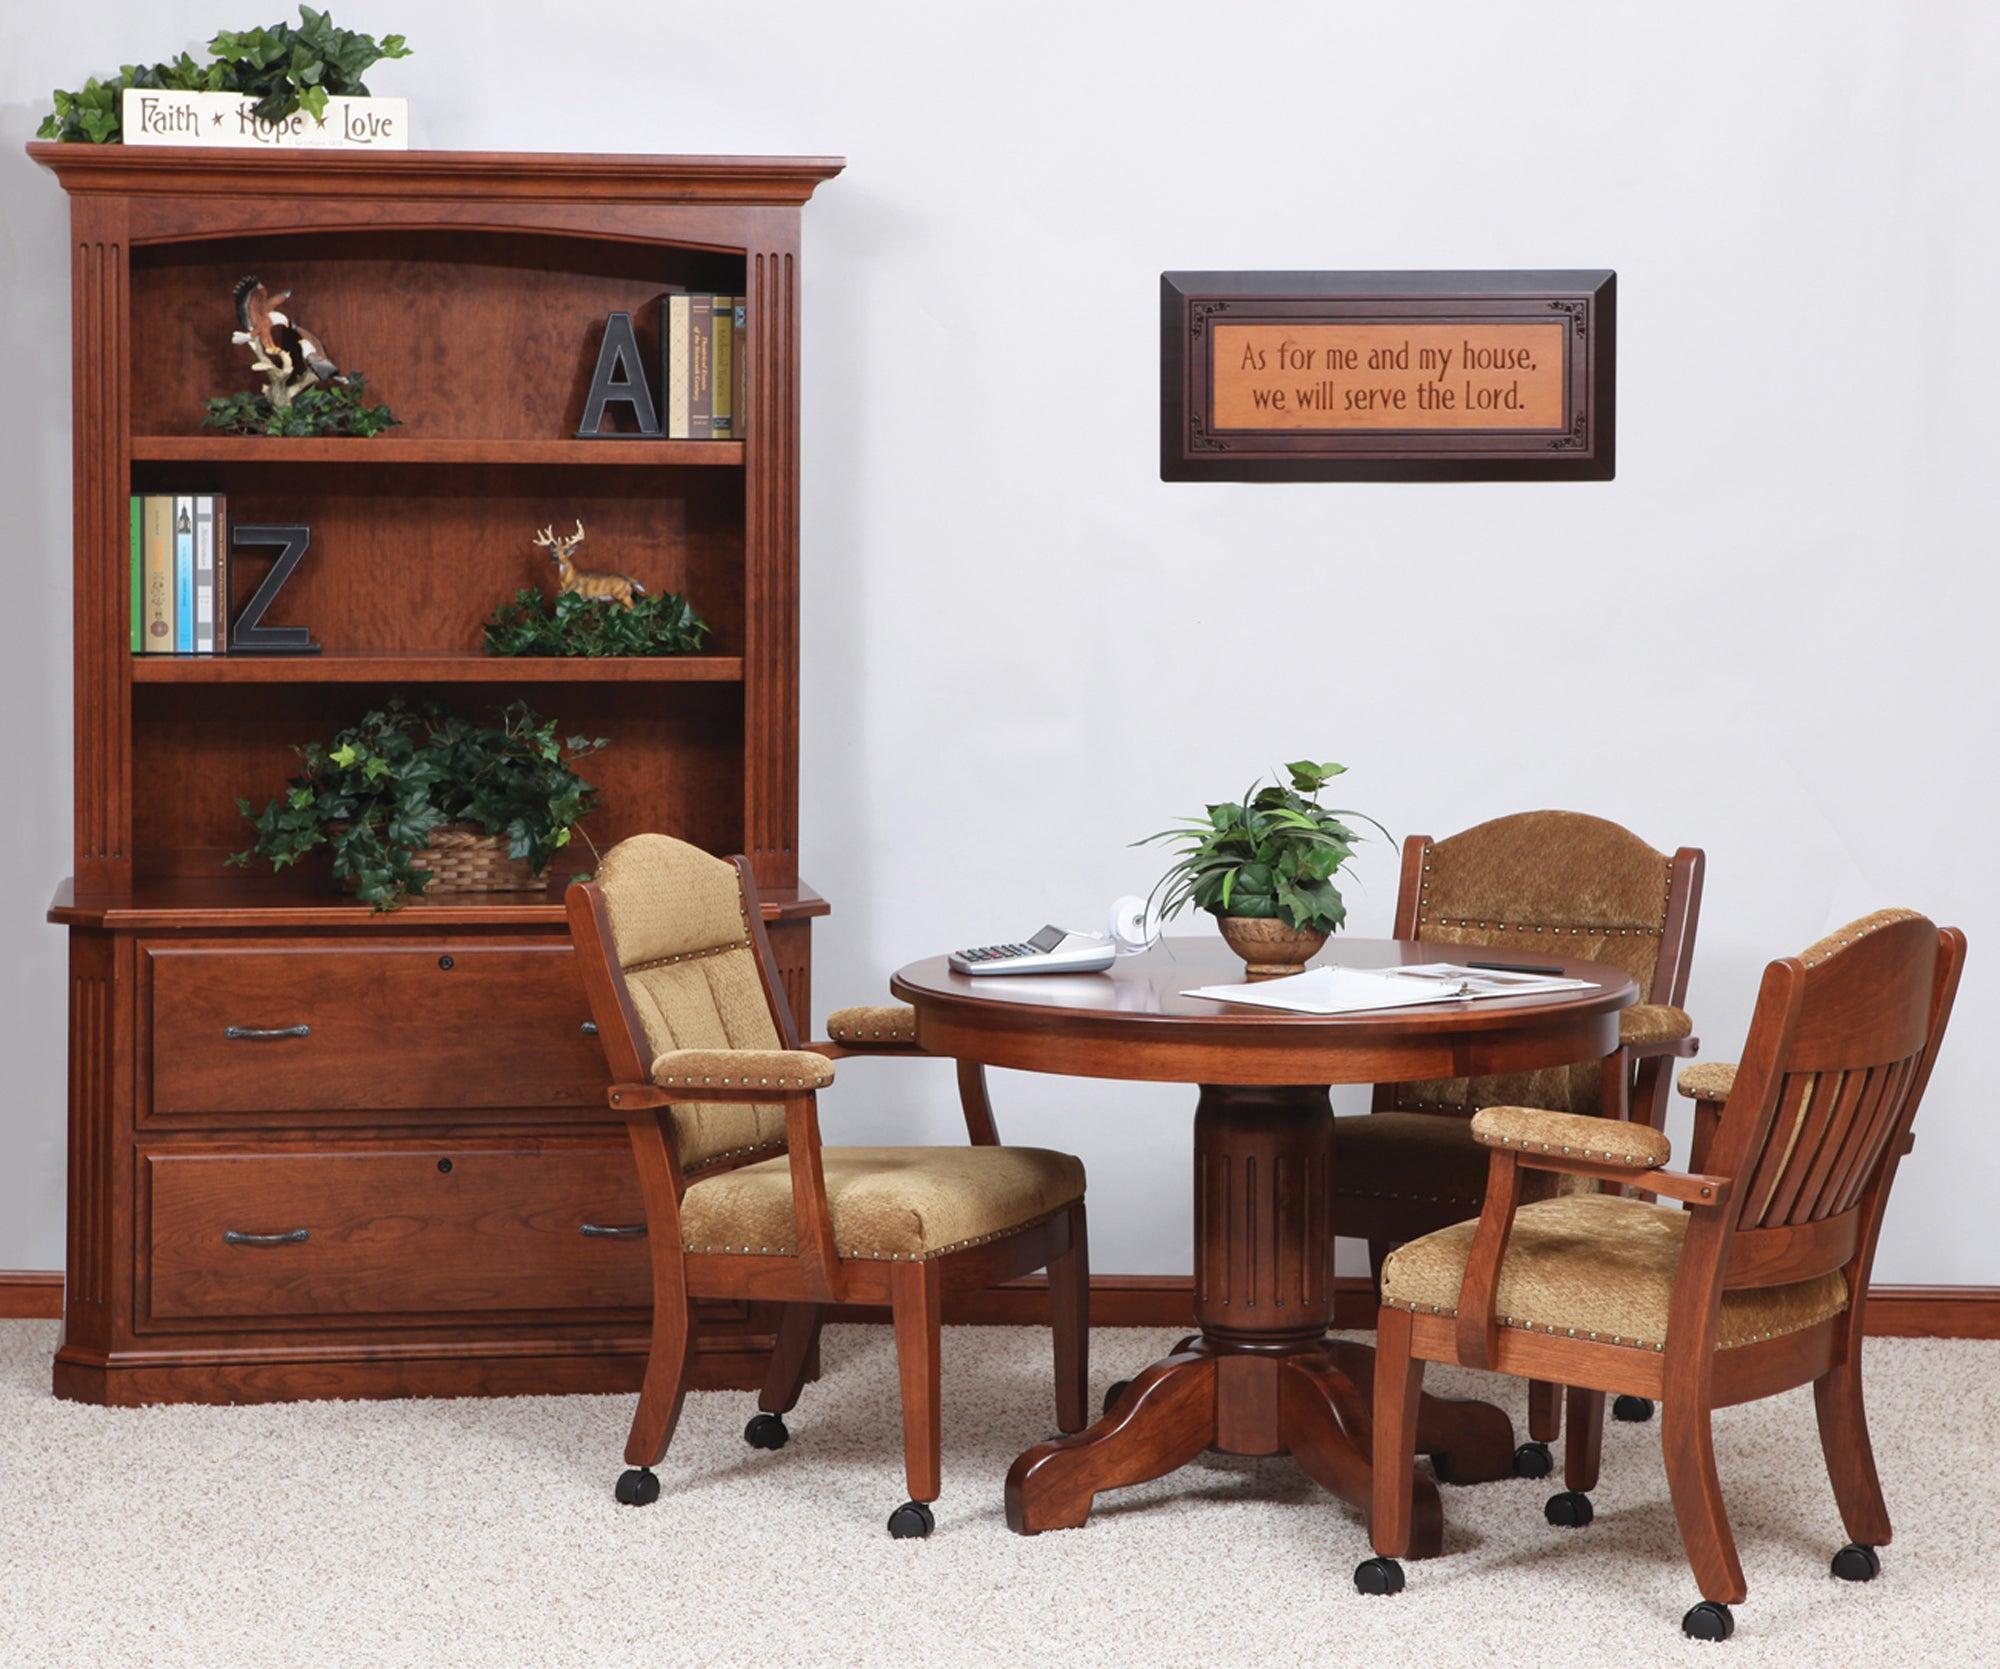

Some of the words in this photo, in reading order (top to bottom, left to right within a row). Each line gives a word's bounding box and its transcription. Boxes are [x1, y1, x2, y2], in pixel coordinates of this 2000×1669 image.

[140, 98, 200, 137] Faith
[236, 101, 302, 143] Hope
[344, 104, 393, 143] Love
[578, 311, 661, 434] A
[1241, 341, 1266, 370] As
[1277, 340, 1316, 370] for
[1326, 349, 1358, 370] me
[1368, 340, 1408, 370] and
[1419, 348, 1452, 382] my
[1463, 340, 1536, 371] house,
[1252, 389, 1286, 410] we
[1296, 381, 1333, 410] will
[1344, 389, 1406, 411] serve
[1417, 380, 1455, 410] the
[1466, 380, 1525, 410] Lord.
[232, 524, 311, 645] Z
